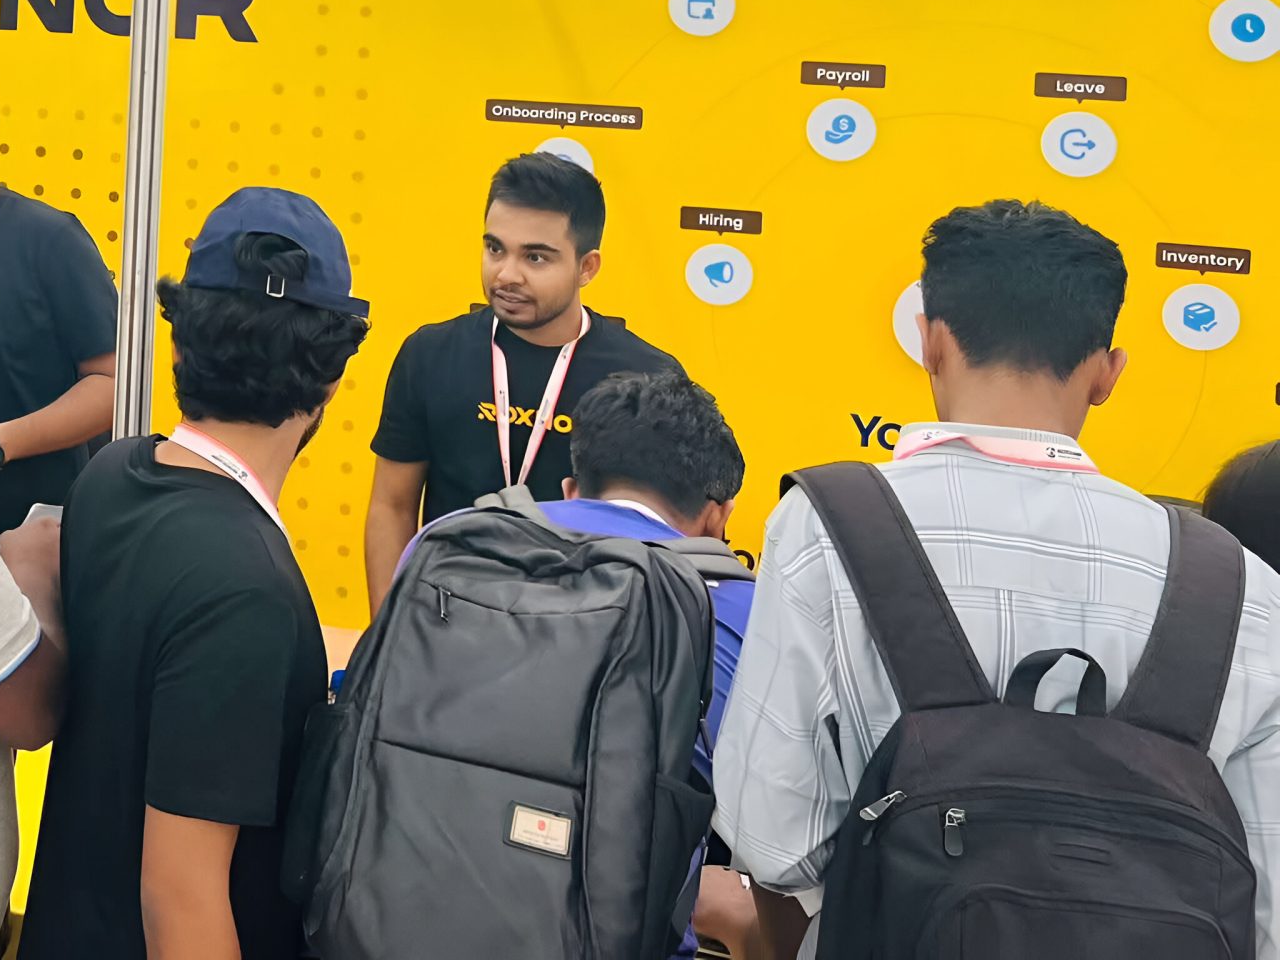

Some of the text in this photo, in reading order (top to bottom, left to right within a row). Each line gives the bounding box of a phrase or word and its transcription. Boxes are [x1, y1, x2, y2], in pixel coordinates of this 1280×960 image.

[816, 68, 870, 84] Payroll
[1056, 80, 1106, 94] Leave
[492, 105, 636, 124] Onboarding Process
[698, 213, 744, 231] Hiring
[1162, 249, 1245, 271] Inventory
